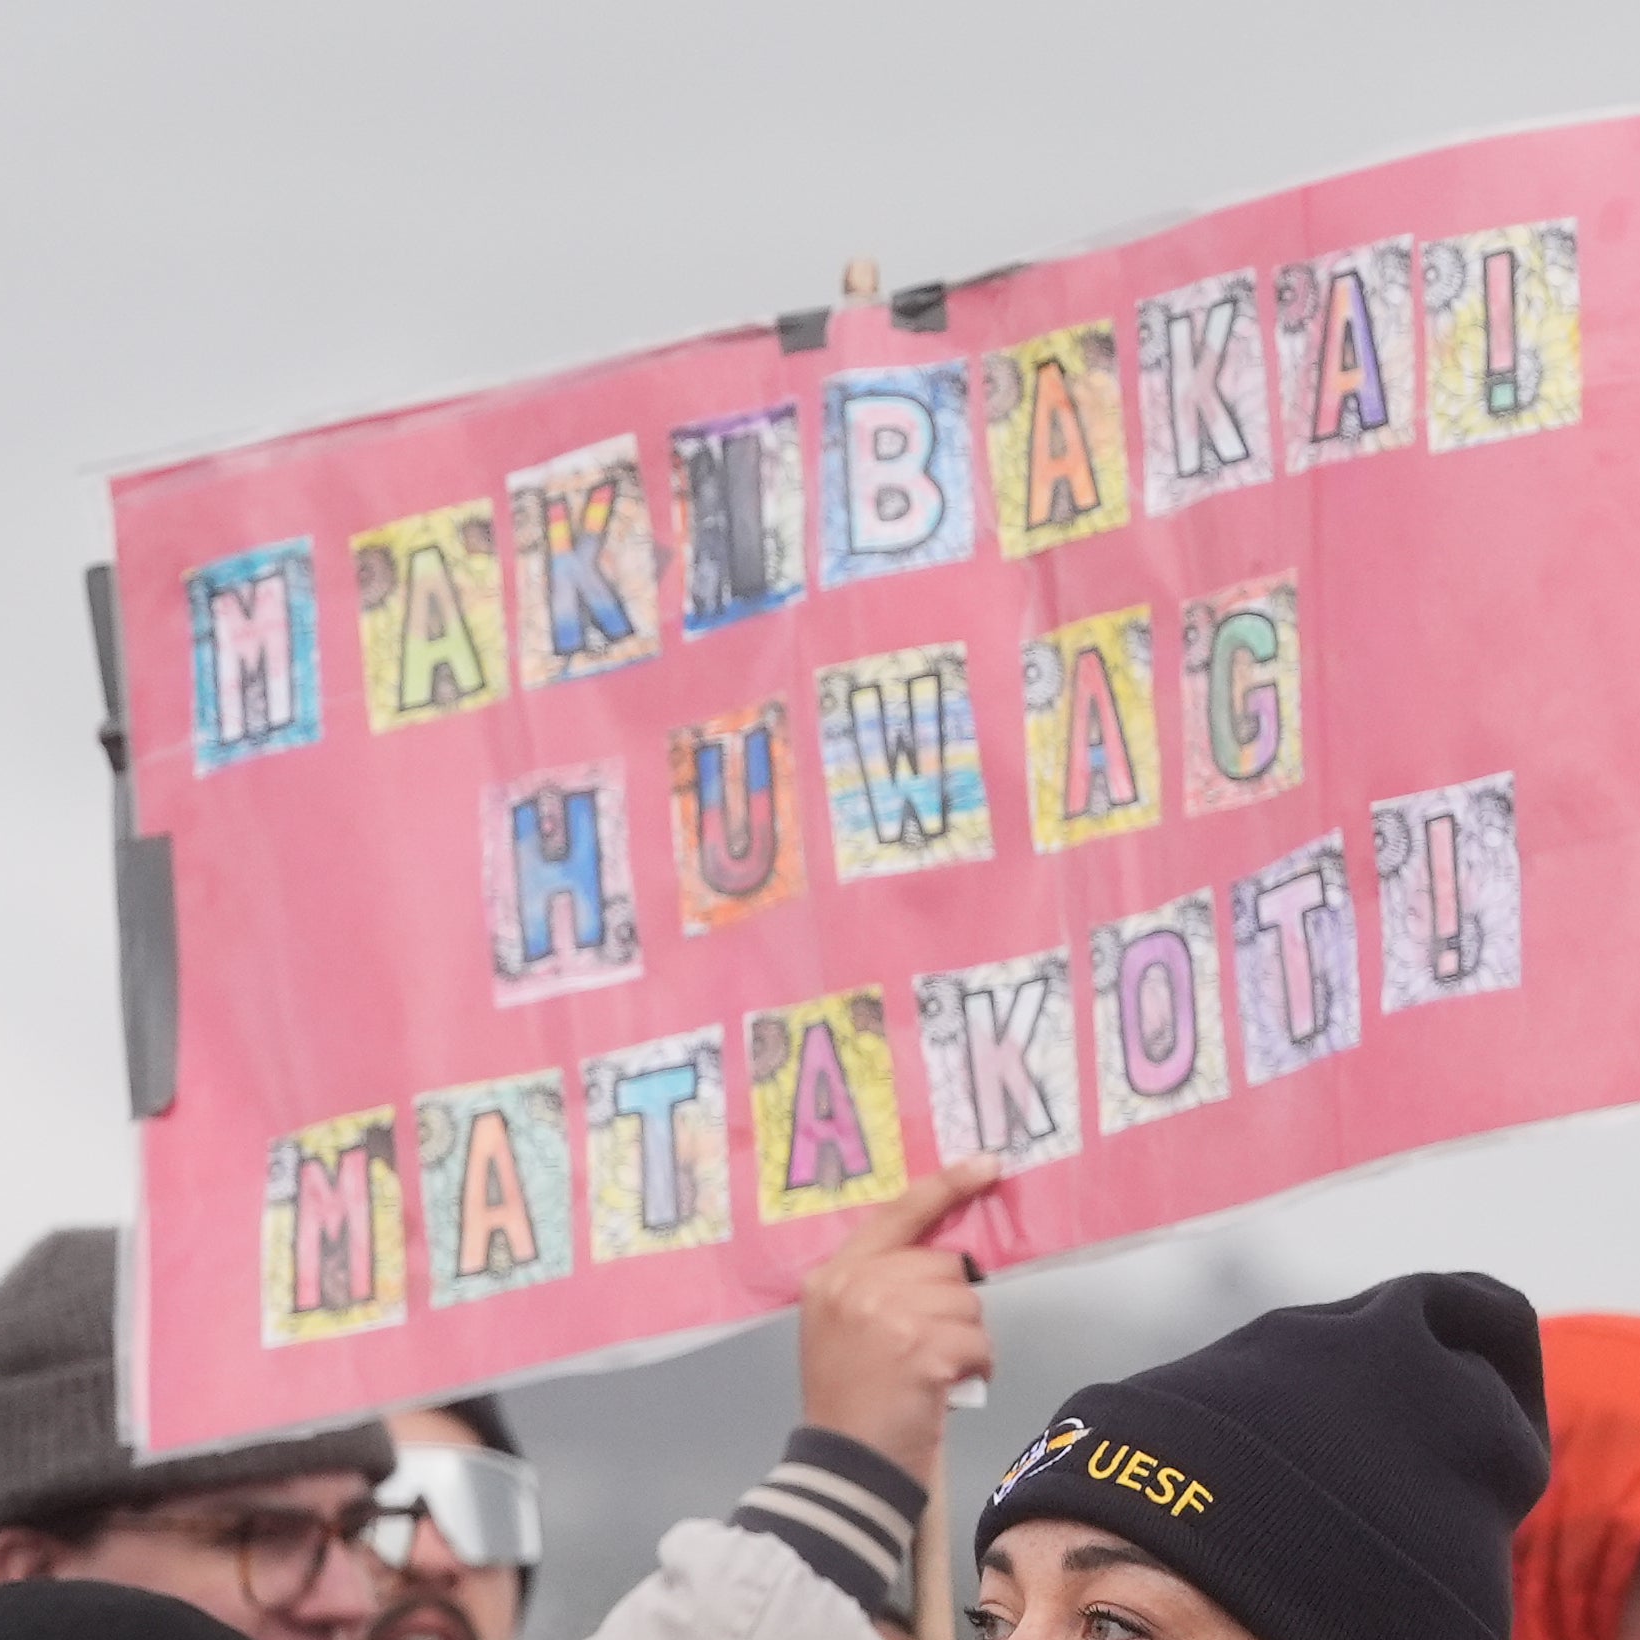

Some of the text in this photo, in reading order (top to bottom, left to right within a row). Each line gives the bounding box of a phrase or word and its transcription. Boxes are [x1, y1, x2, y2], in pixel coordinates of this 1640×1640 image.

[207, 248, 1517, 748] MAKIBAKA!
[511, 610, 1281, 964] HUWAG
[289, 813, 1463, 1316] MATAKOT!
[1087, 1438, 1215, 1518] UESF
